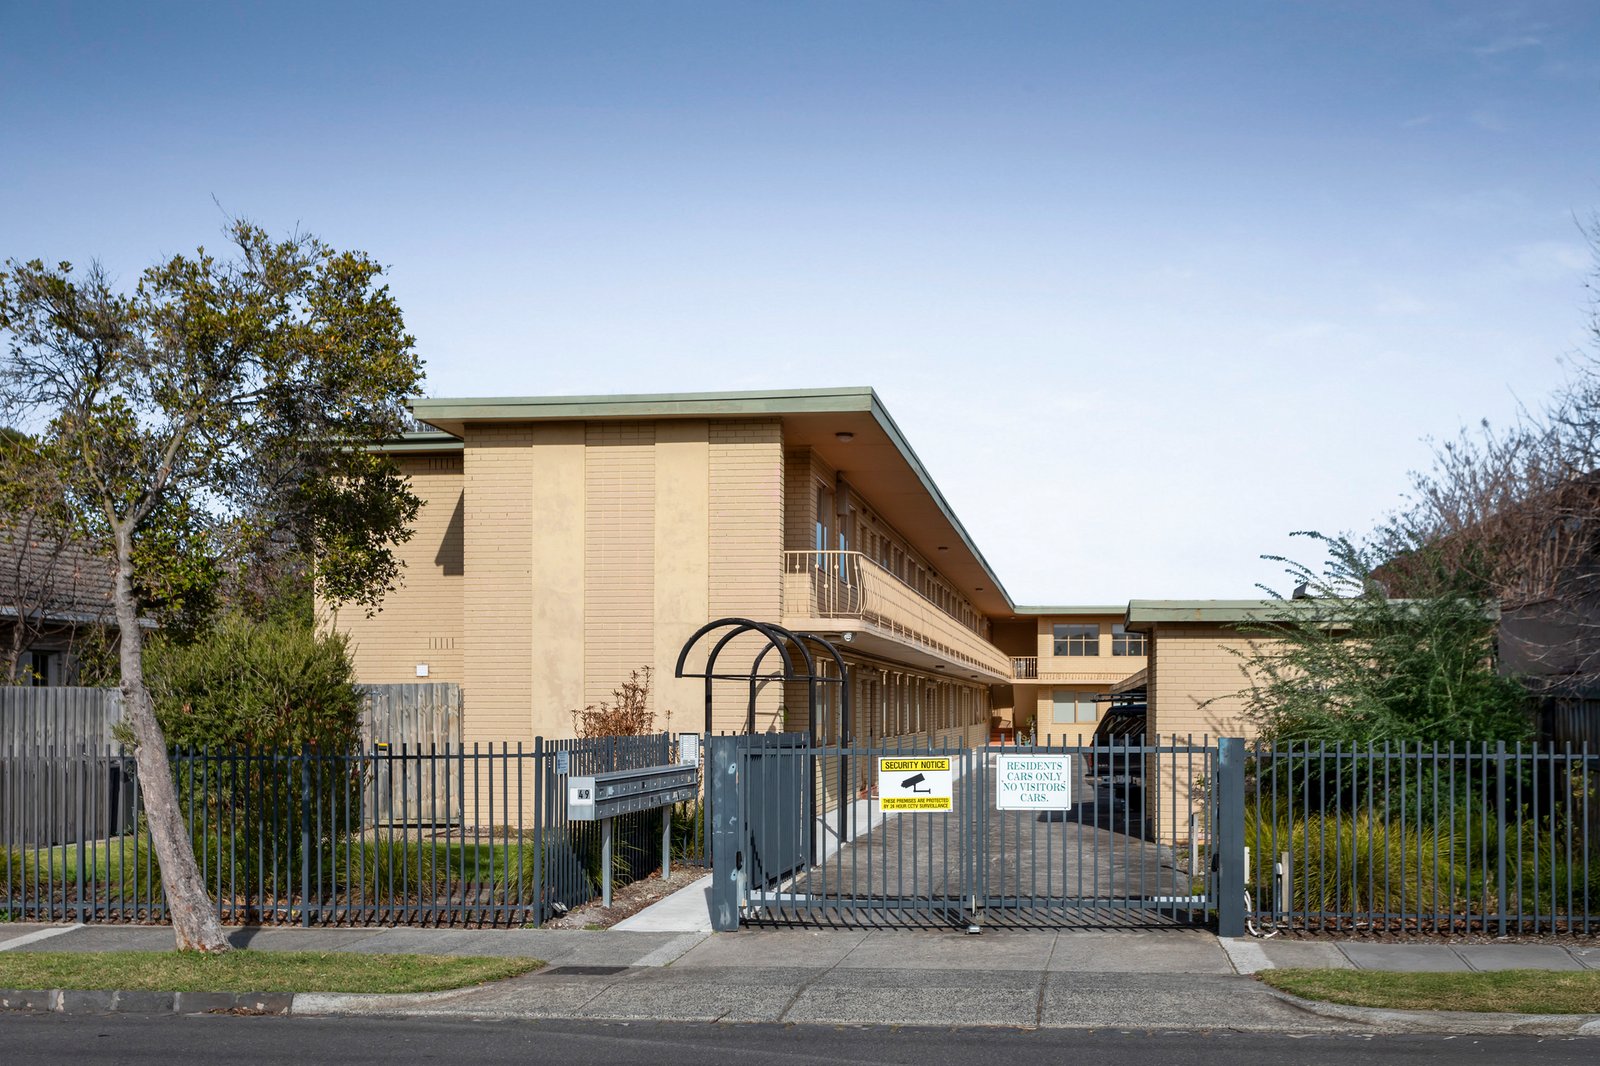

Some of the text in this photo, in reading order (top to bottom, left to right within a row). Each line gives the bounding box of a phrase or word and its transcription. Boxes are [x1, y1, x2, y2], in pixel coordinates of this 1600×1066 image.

[885, 760, 945, 769] SECURITY NOTICE
[1007, 761, 1063, 770] RESIDENTS
[1007, 772, 1062, 781] CARS ONLY
[1003, 782, 1066, 791] NO VISITORS
[578, 789, 590, 799] 49
[1020, 793, 1049, 802] CARS.
